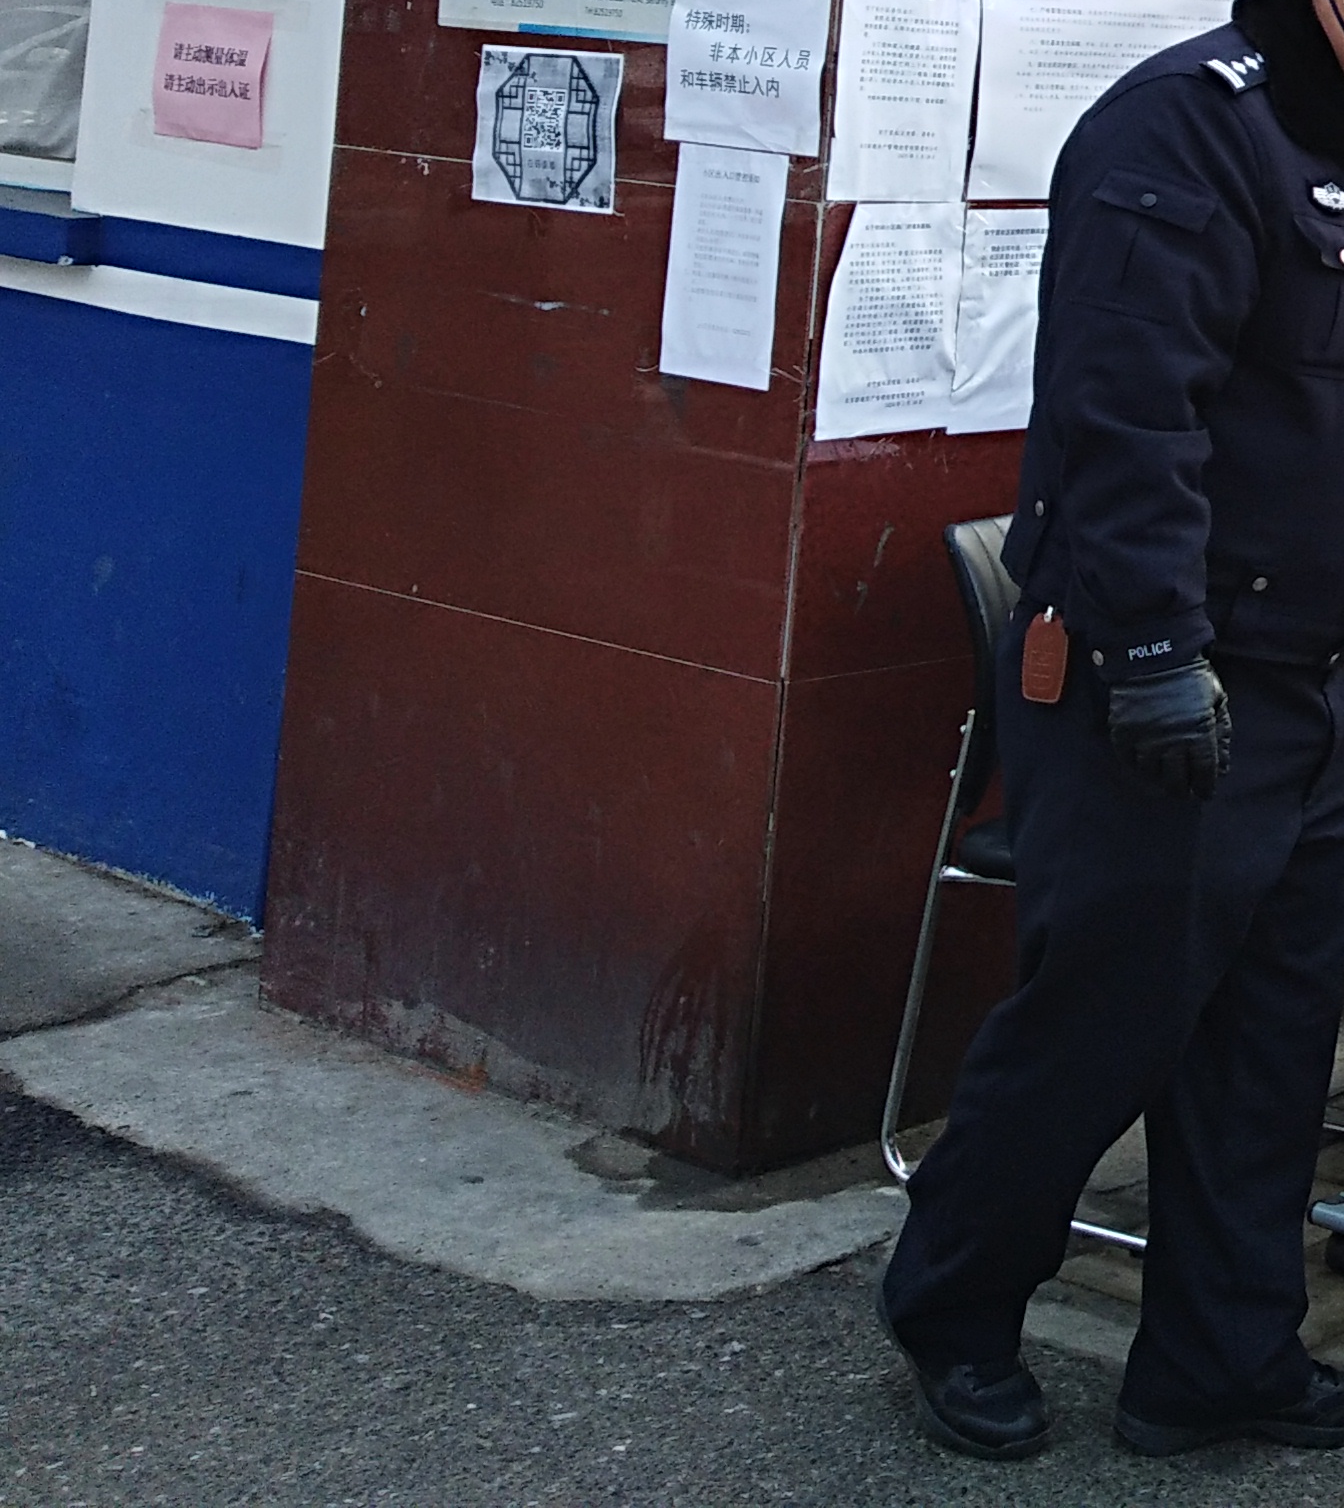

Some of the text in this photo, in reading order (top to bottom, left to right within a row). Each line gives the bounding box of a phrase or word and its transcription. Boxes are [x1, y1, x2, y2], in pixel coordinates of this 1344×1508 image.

[685, 9, 751, 34] 特殊时期：
[173, 42, 249, 67] 请主动测量体温
[709, 41, 811, 71] 非本小区人员
[680, 68, 780, 99] 和车辆禁止入内
[1128, 639, 1173, 661] POLICE
